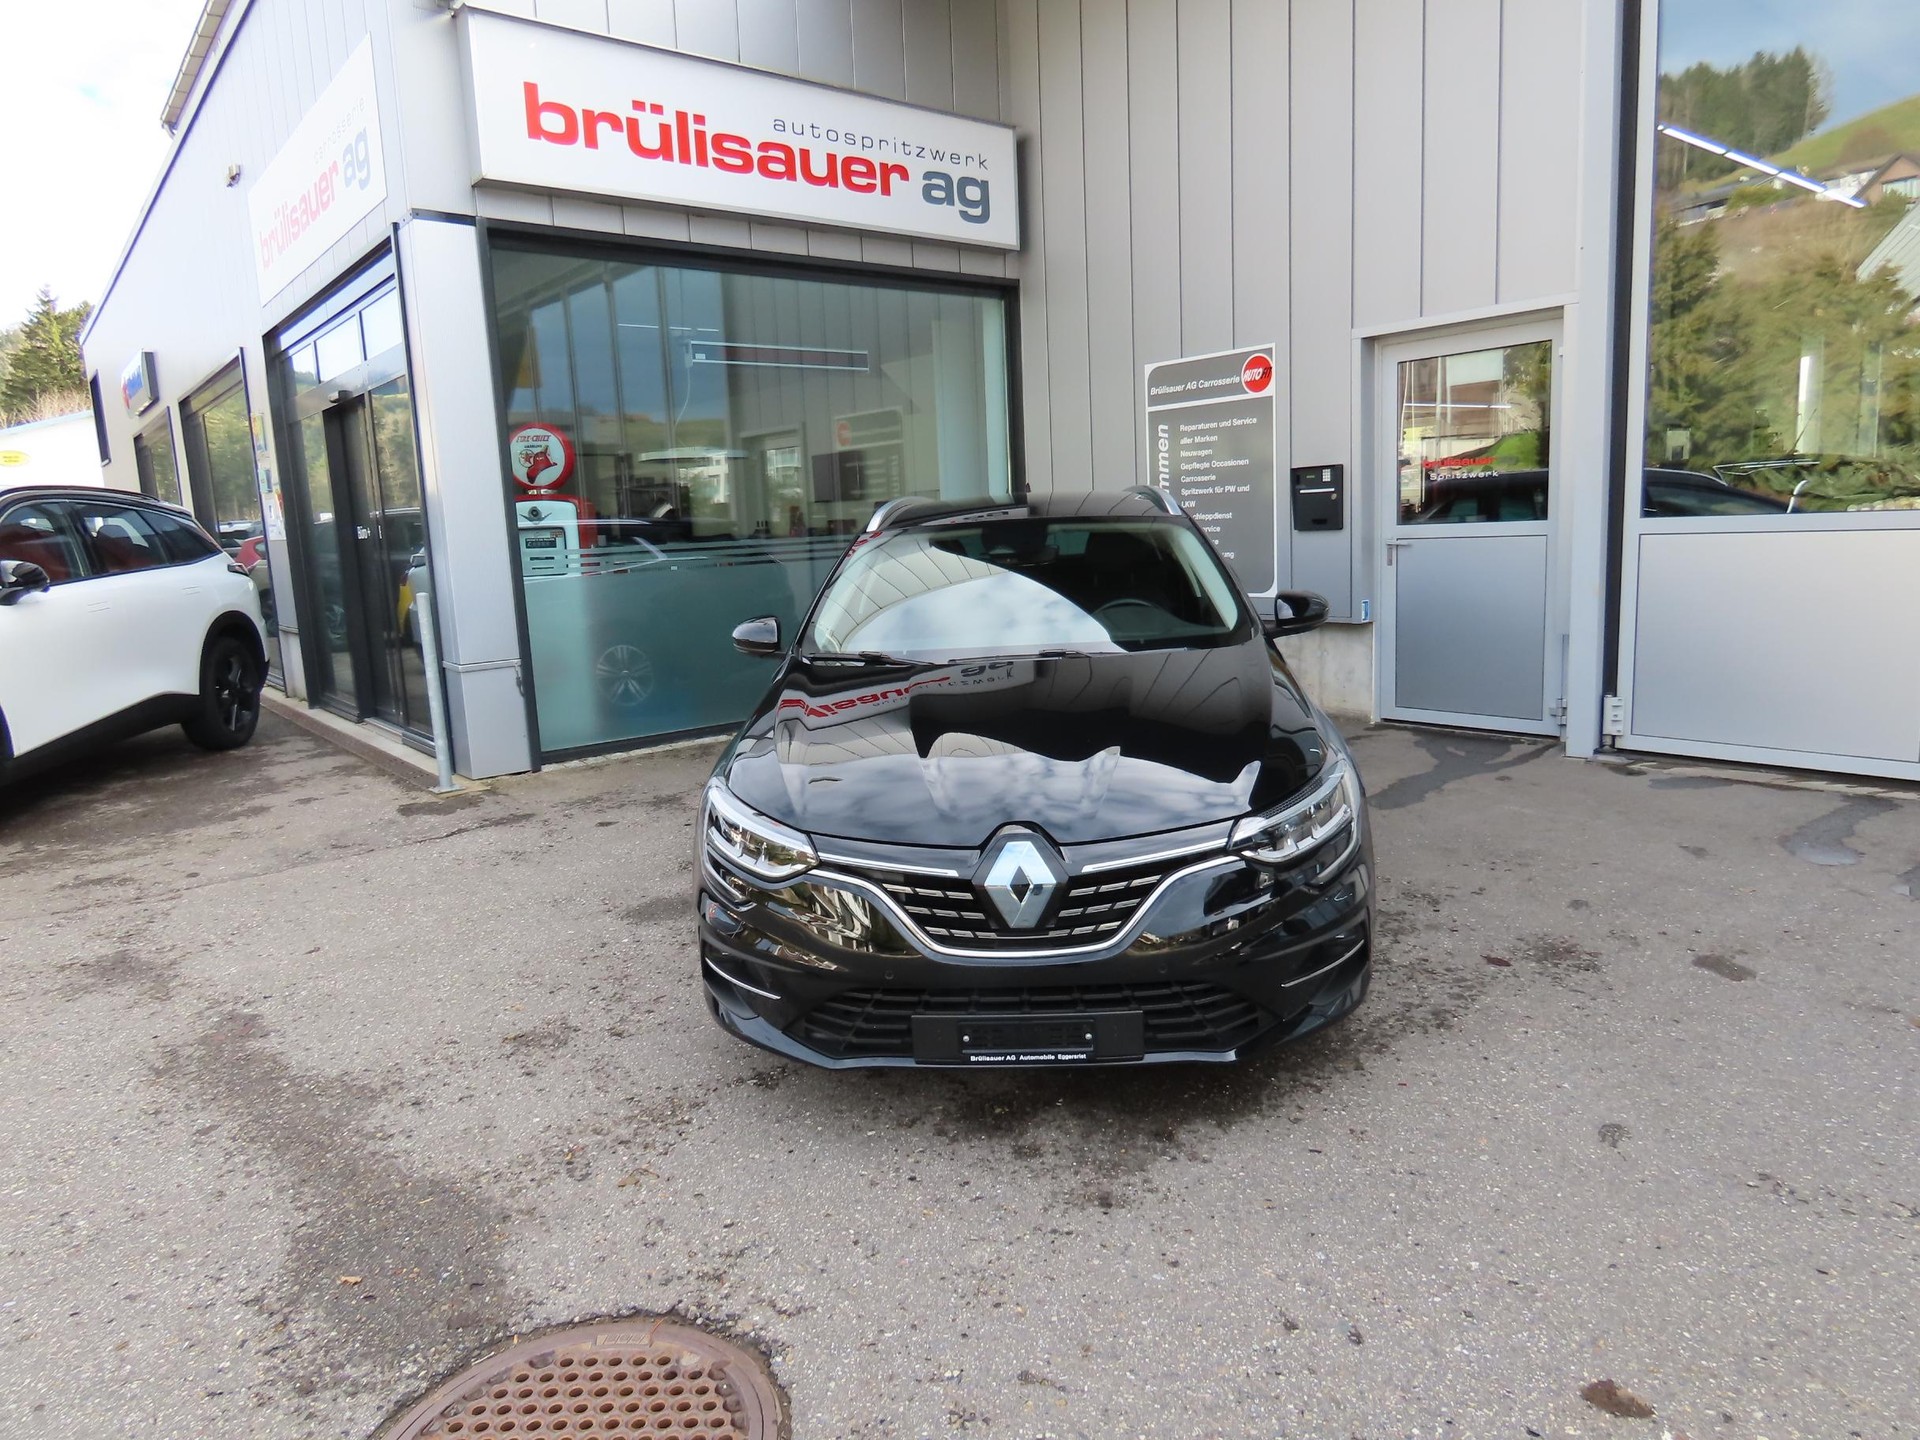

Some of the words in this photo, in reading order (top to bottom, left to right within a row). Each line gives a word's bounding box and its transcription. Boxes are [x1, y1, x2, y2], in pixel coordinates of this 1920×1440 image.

[773, 117, 989, 170] autospritzwerk
[522, 82, 910, 197] brülisauer
[921, 169, 991, 224] ag
[258, 160, 339, 270] brülisauer
[342, 126, 371, 191] ag
[1243, 366, 1272, 382] AUTOFIT
[1150, 383, 1185, 396] Brülisauer
[1186, 380, 1197, 391] AG
[1198, 375, 1240, 389] Carrosserie
[1180, 421, 1218, 432] Reparaturen
[1219, 419, 1231, 428] und
[1232, 417, 1257, 426] Service
[1180, 436, 1193, 445] aller
[1194, 434, 1218, 443] Marken
[1158, 424, 1170, 493] mmen
[1180, 449, 1213, 458] Neuwagen
[1180, 461, 1210, 471] Gepflegte
[1211, 458, 1249, 468] Occasionen
[1180, 474, 1216, 483] Carrosserie
[1429, 470, 1499, 481] Spritzwerk
[1181, 487, 1214, 497] Spritzwerk
[1214, 486, 1224, 494] für
[1224, 485, 1237, 493] PW
[1237, 484, 1250, 492] und
[1181, 500, 1196, 508] LKW
[1193, 511, 1232, 521] chleppdienst
[970, 1054, 1005, 1062] Brülisauer
[1019, 1053, 1055, 1061] Automobile
